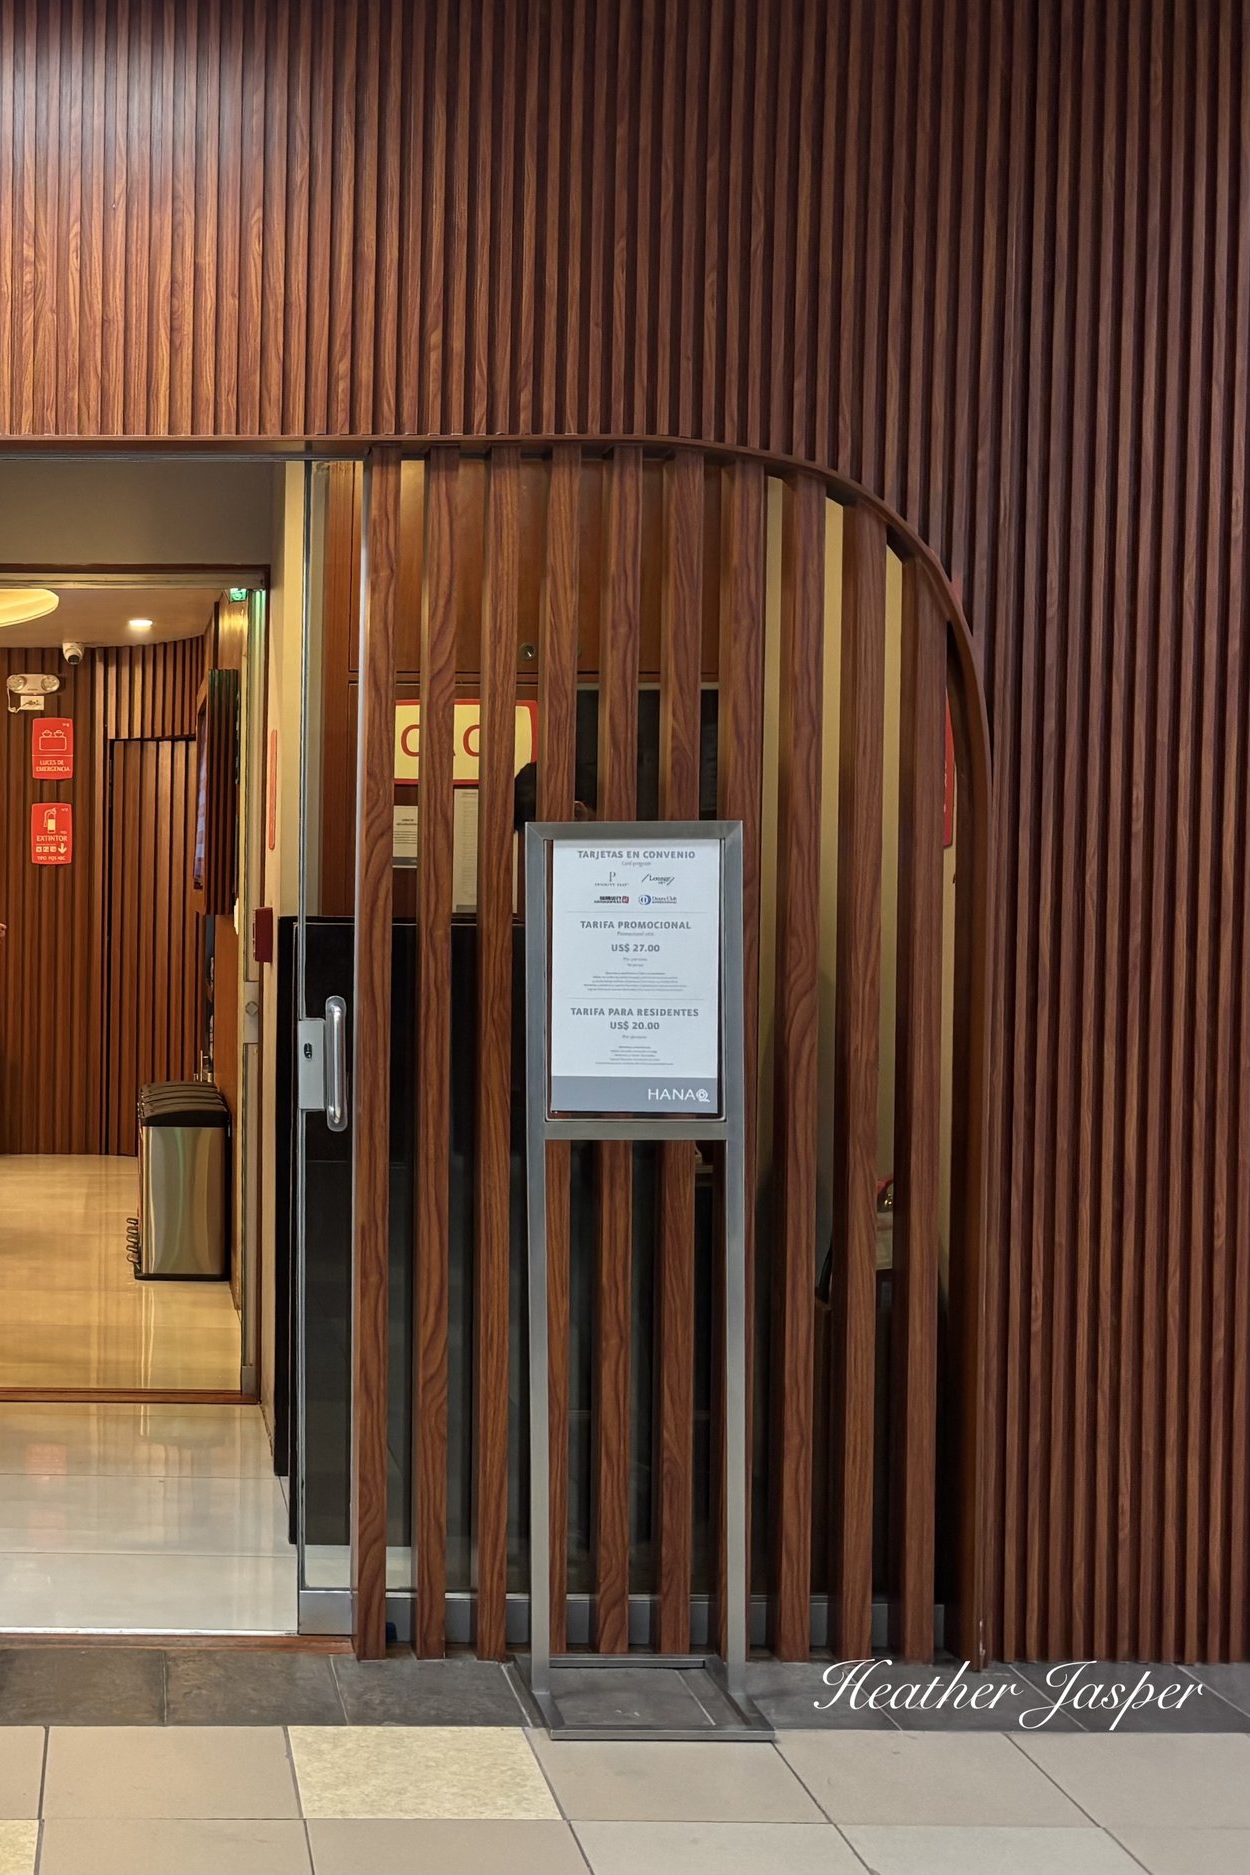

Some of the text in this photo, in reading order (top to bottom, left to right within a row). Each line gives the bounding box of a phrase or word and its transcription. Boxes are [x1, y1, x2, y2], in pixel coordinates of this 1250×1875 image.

[577, 850, 696, 860] TARJETAS EN CONVENIO
[580, 920, 691, 930] TARIFA PROMOCIONAL
[611, 943, 660, 953] US$ 27.00
[570, 1007, 699, 1017] TARIFA PARA RESIDENTES
[610, 1021, 660, 1031] US$ 20.00
